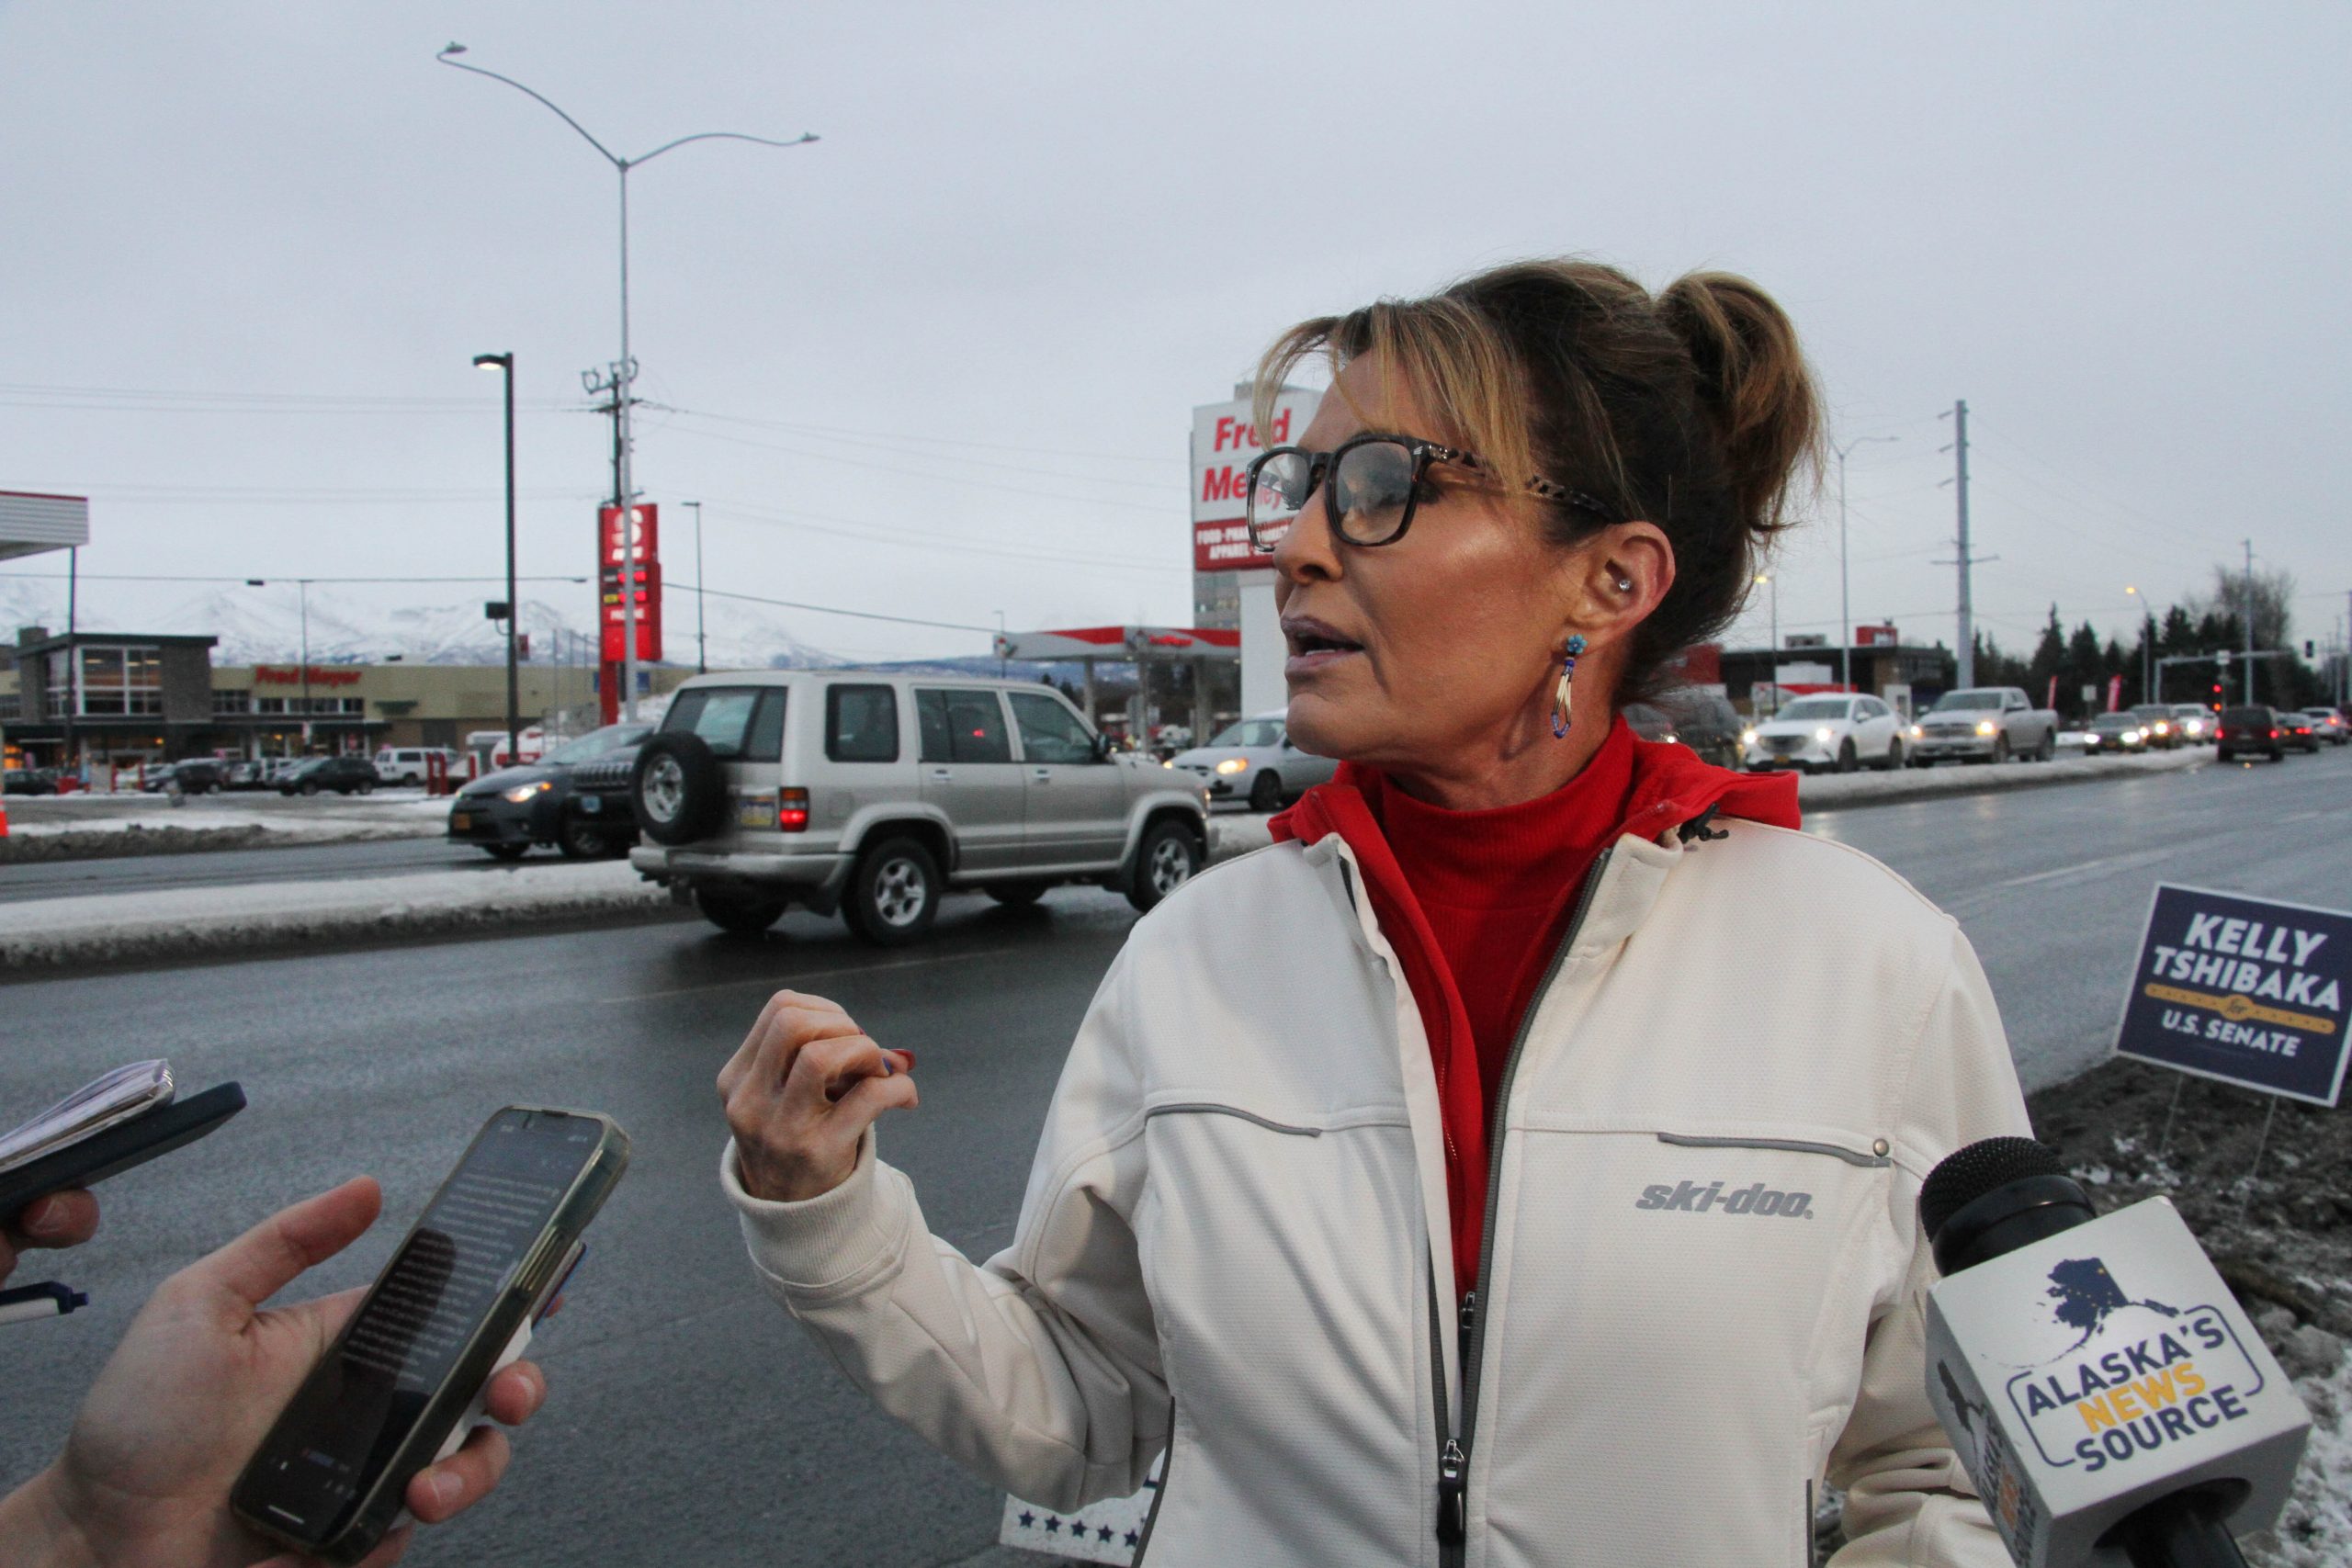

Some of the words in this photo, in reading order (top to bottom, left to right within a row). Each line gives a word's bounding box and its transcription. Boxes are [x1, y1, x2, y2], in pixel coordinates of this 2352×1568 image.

[2184, 912, 2328, 967] KELLY
[2152, 944, 2340, 1011] TSHIBAKA
[2161, 1009, 2199, 1035] U.S.
[2204, 1019, 2301, 1057] SENATE
[2027, 1317, 2224, 1417] ALASKA'S
[2076, 1362, 2206, 1434] NEWS
[2075, 1384, 2248, 1472] SOURCE
